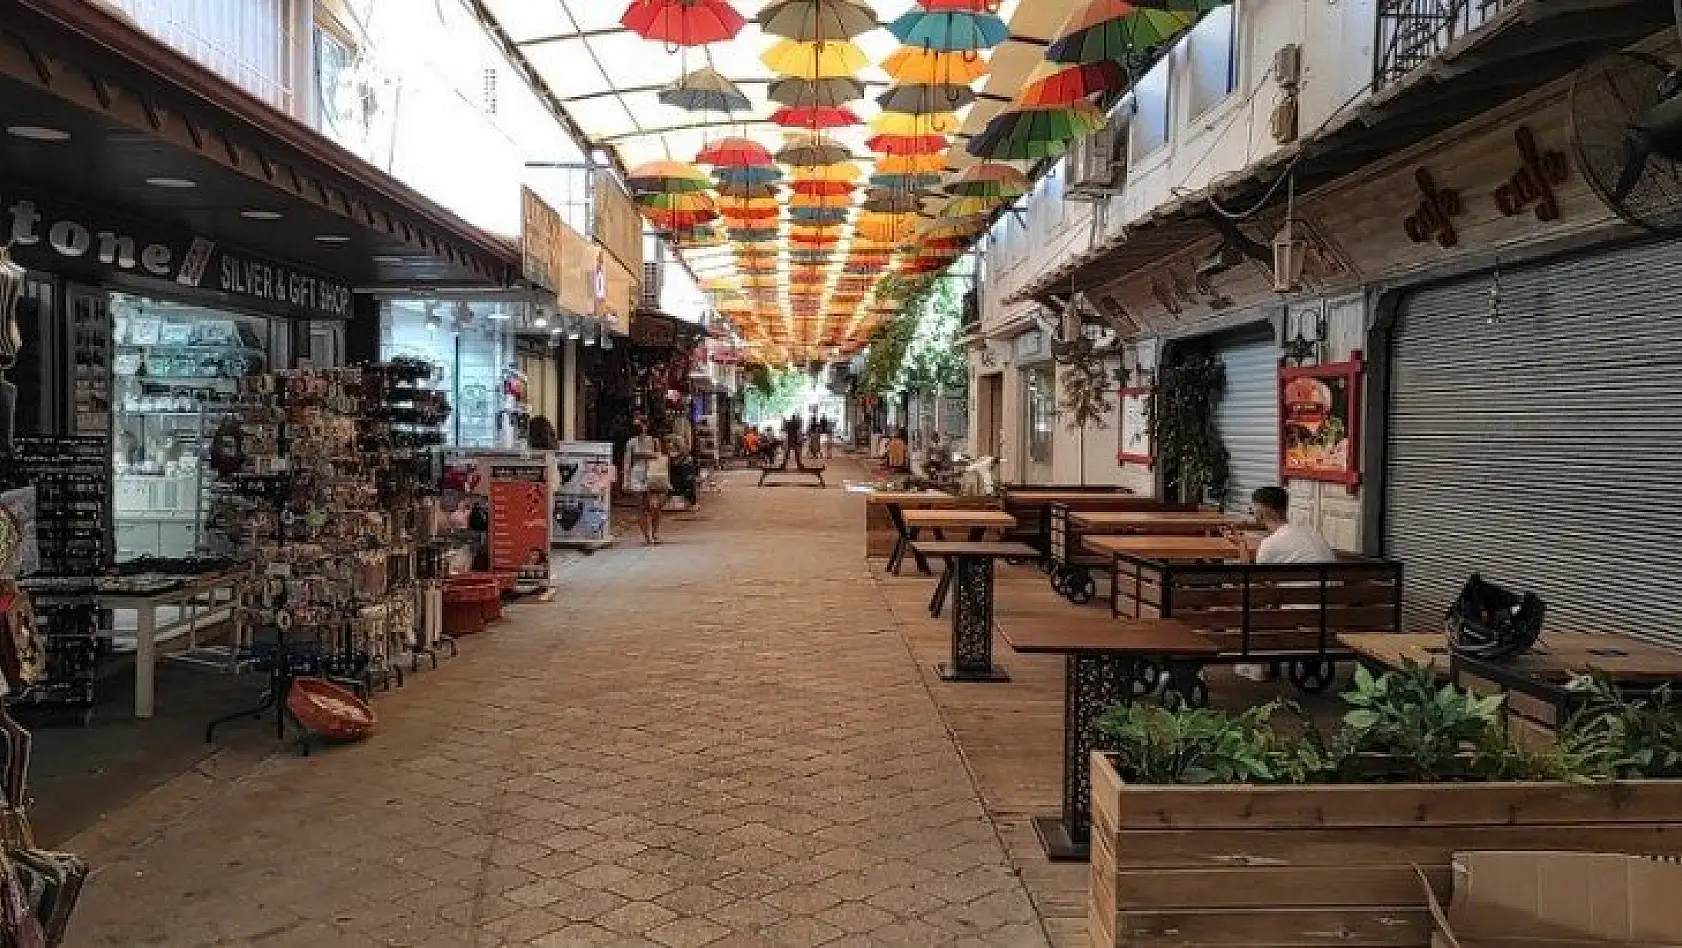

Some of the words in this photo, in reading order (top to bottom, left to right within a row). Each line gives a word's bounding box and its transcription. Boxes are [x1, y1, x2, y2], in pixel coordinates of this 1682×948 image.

[9, 200, 172, 274] tone
[219, 254, 273, 300] SILVER
[275, 267, 286, 301] &
[289, 271, 317, 309] GIFT
[319, 279, 349, 316] SHOP
